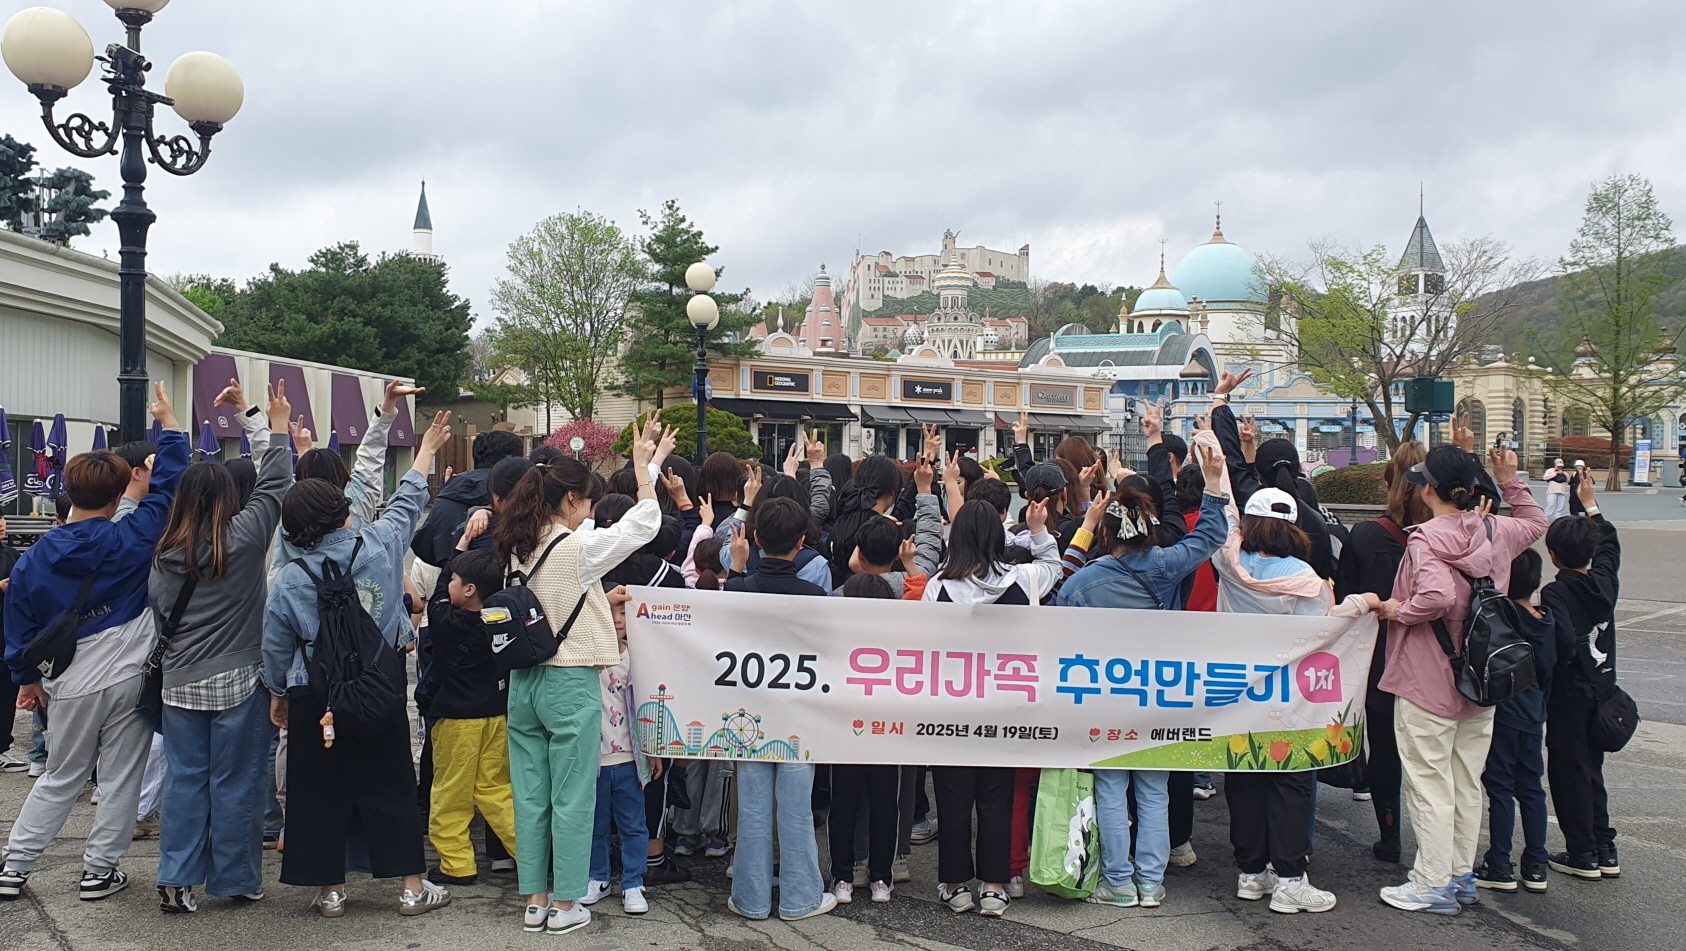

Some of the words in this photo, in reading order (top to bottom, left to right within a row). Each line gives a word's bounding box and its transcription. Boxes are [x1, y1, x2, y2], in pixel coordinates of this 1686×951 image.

[79, 606, 111, 620] odak
[493, 633, 508, 645] NIKE
[714, 651, 830, 693] 2025.
[846, 648, 1039, 702] 우리가족
[1056, 654, 1290, 708] 추억만들기
[1304, 667, 1334, 692] 1차
[916, 723, 969, 737] 2025년
[973, 725, 998, 738] 4월
[1002, 726, 1058, 740] 19일(토)
[1151, 728, 1212, 742] 에버랜드
